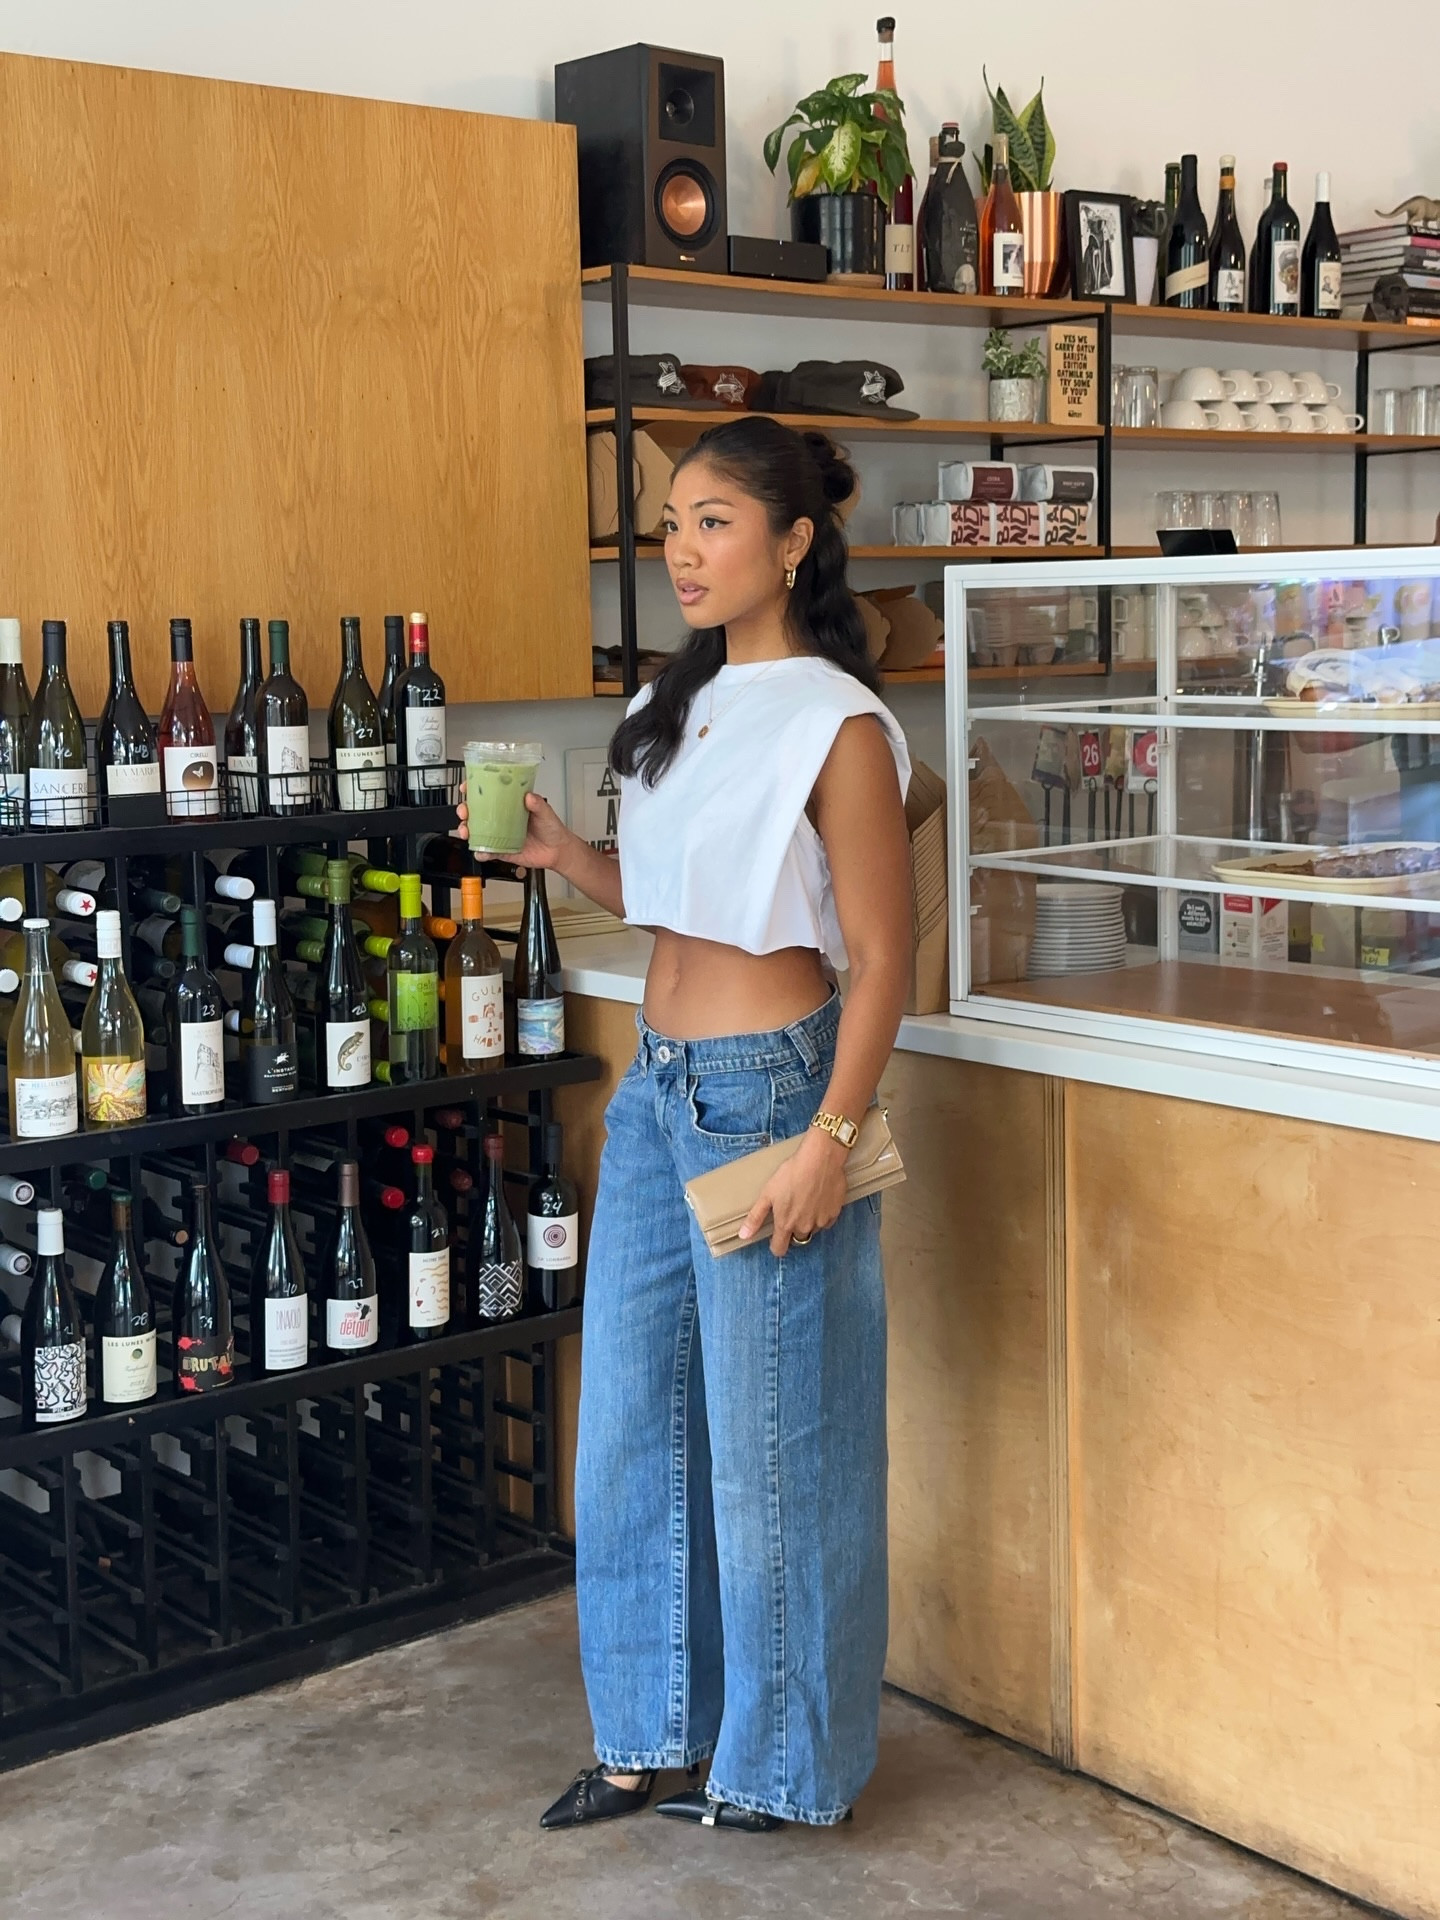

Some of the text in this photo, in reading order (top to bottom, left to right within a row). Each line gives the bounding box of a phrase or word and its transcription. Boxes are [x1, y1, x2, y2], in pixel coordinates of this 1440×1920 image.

[1063, 335, 1088, 344] YES WE
[1054, 342, 1096, 354] CARRY OATLY
[1063, 352, 1088, 361] BARISTA
[1063, 361, 1088, 370] EDITION
[1056, 369, 1094, 380] OATMILK SO
[1059, 378, 1091, 388] TRY SOME
[1062, 387, 1088, 397] IF YOU'D
[421, 688, 442, 701] 22
[355, 728, 374, 739] 27
[353, 750, 374, 758] LUNES
[1083, 743, 1100, 767] 26
[202, 1004, 216, 1017] 23
[542, 1201, 563, 1215] 24
[282, 1282, 298, 1298] 40
